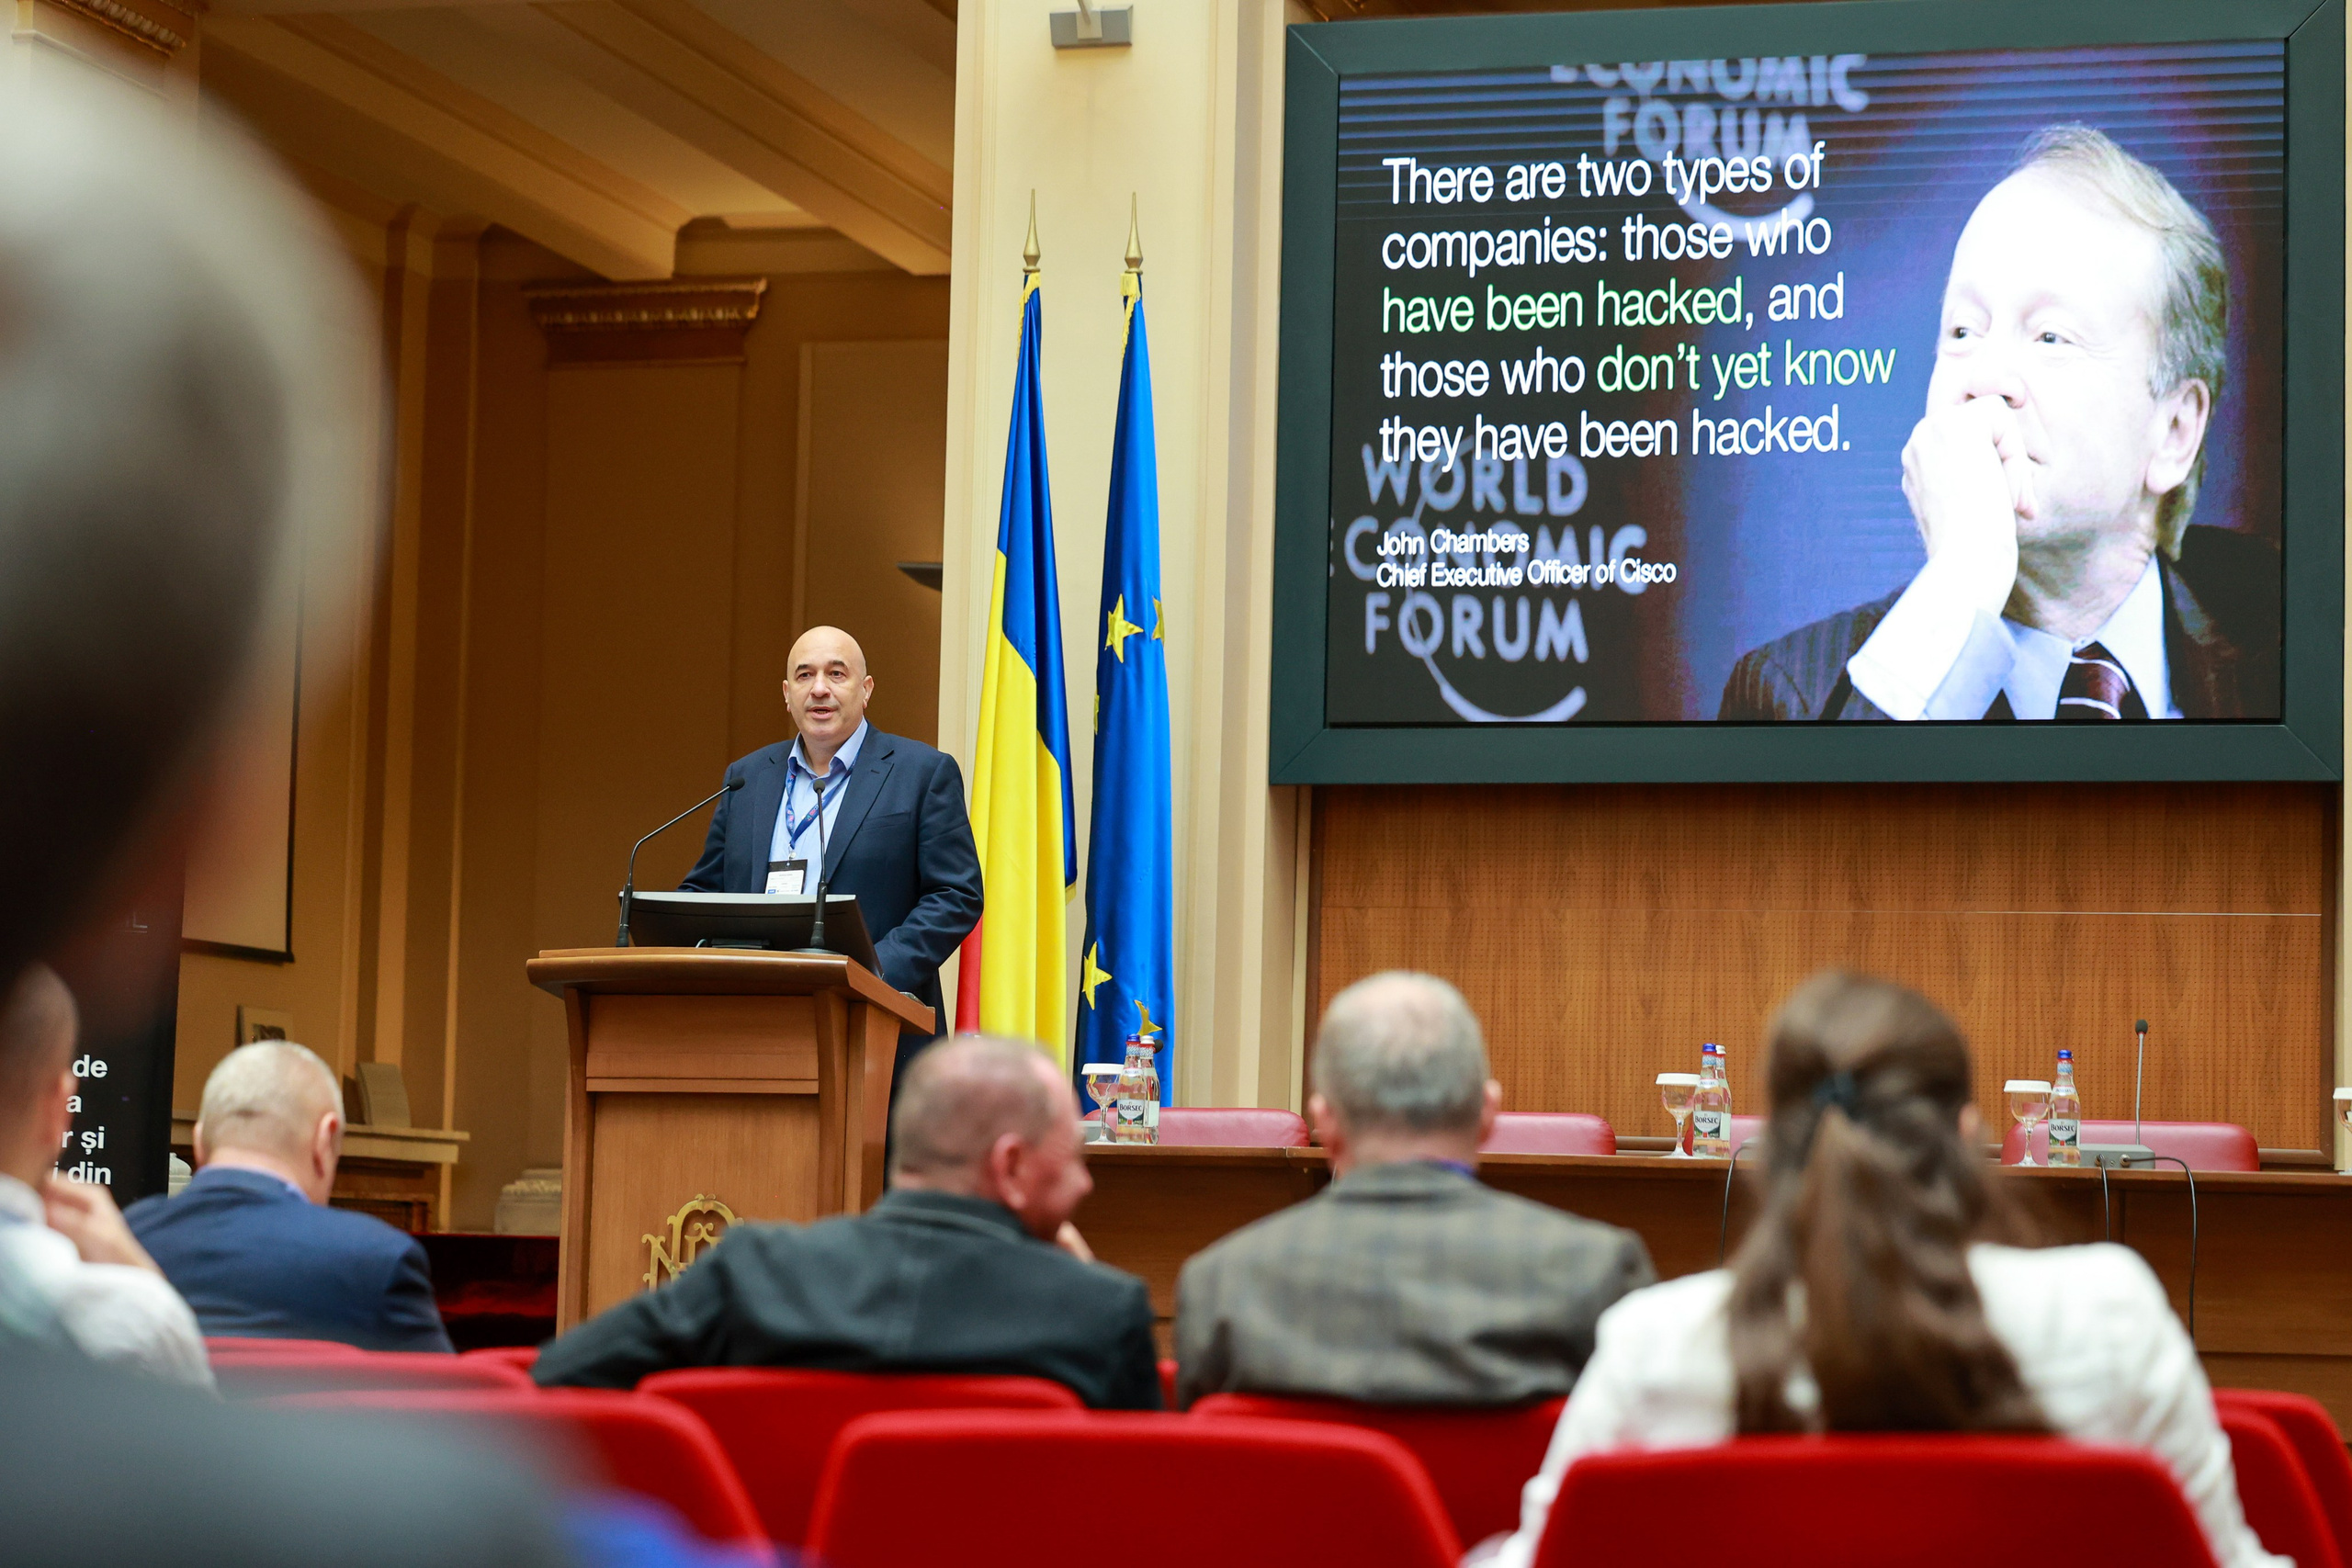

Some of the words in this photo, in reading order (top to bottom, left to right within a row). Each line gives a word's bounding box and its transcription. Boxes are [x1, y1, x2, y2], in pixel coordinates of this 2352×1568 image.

[1381, 156, 1494, 204] There
[1505, 161, 1566, 202] are
[1577, 152, 1652, 197] two
[1662, 150, 1773, 206] types
[1784, 141, 1826, 190] of
[1381, 216, 1608, 278] companies:
[1621, 213, 1734, 261] those
[1744, 208, 1833, 257] who
[1382, 287, 1475, 333] have
[1487, 284, 1583, 332] been
[1598, 276, 1754, 331] hacked,
[1768, 271, 1844, 321] and
[1380, 351, 1489, 399] those
[1500, 346, 1586, 395] who
[1712, 342, 1772, 400] yet
[1784, 339, 1897, 387] know
[1379, 415, 1464, 473] they
[1475, 413, 1568, 461] have
[1580, 410, 1678, 458] been
[1692, 403, 1850, 456] hacked.
[1362, 442, 1589, 517] WORLD
[1376, 530, 1425, 557] John
[1430, 528, 1530, 554] Chambers
[1376, 561, 1428, 588] Chief
[1430, 559, 1523, 587] Executive
[1527, 558, 1590, 585] Officer
[1594, 558, 1617, 584] of
[1619, 557, 1678, 584] Cisco
[1365, 591, 1589, 663] FORUM
[72, 1054, 108, 1078] de
[1119, 1103, 1143, 1111] BORSEC
[1694, 1115, 1719, 1124] BORSEC
[2051, 1123, 2075, 1133] BORSEC
[67, 1161, 112, 1186] din
